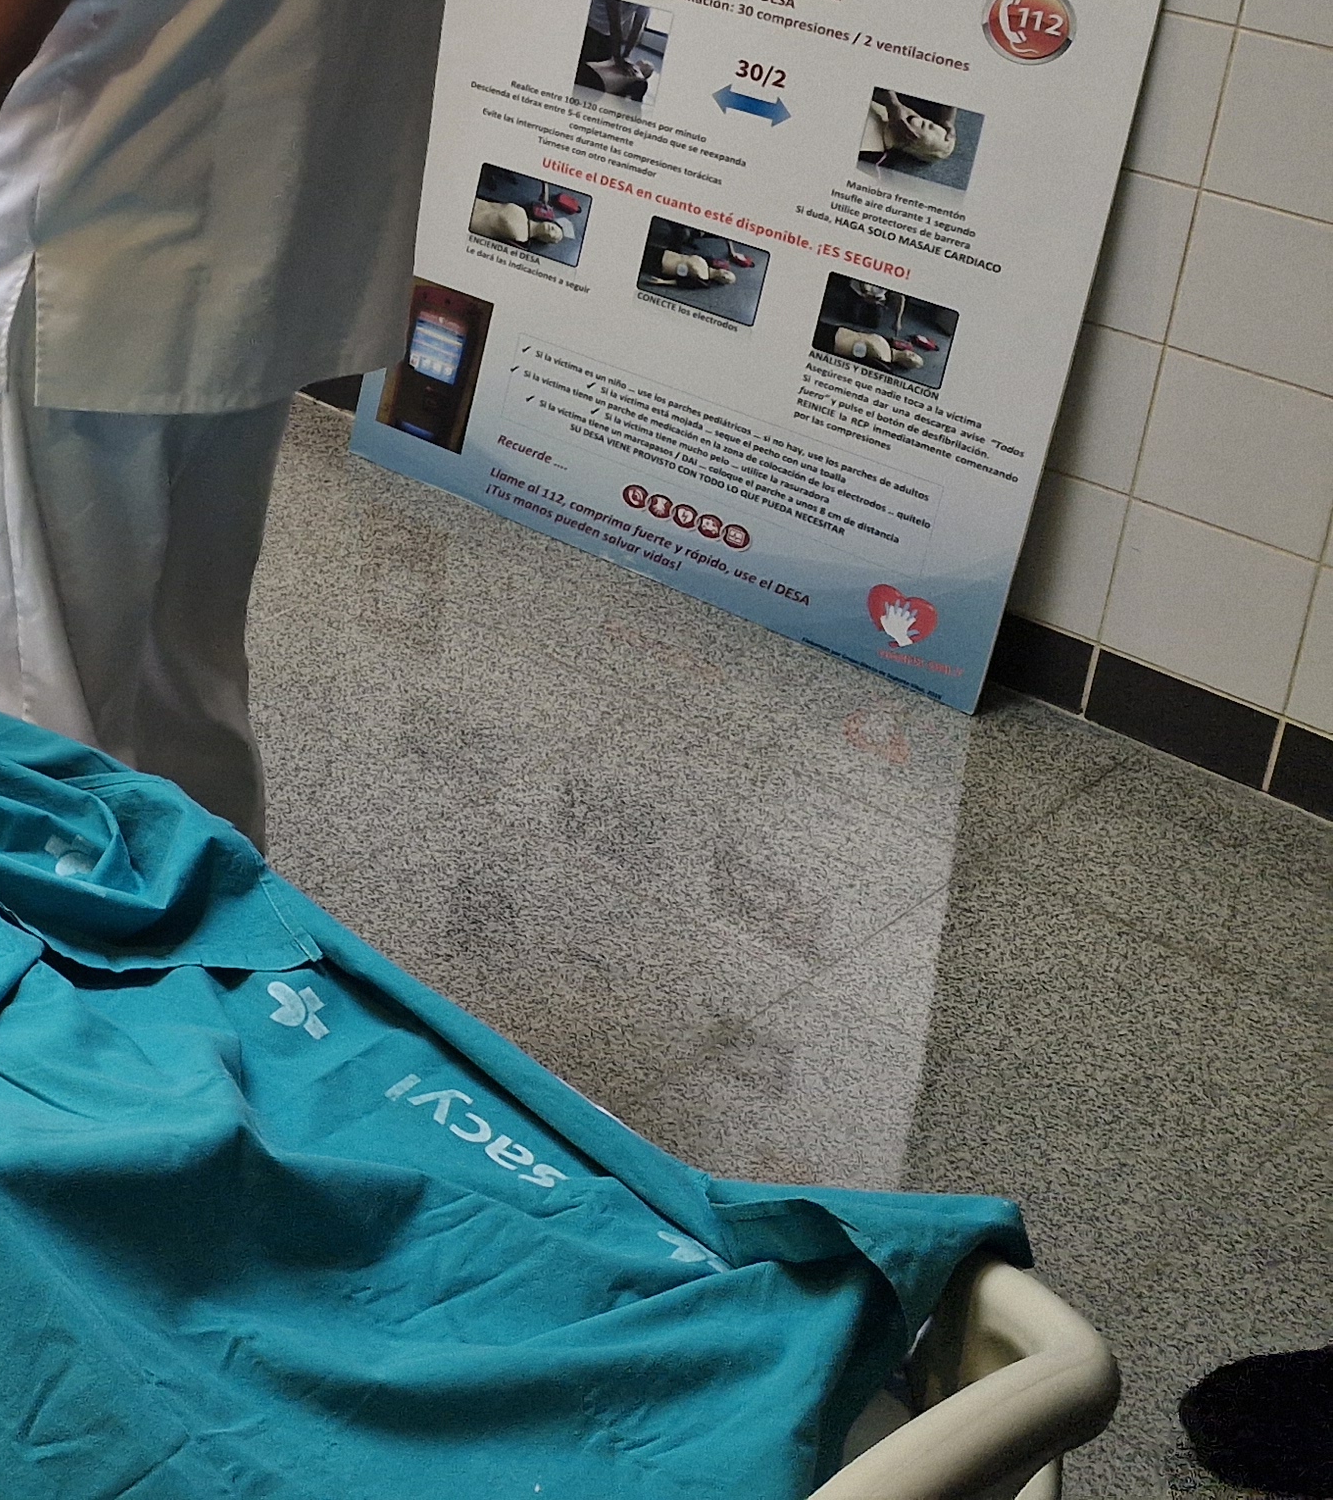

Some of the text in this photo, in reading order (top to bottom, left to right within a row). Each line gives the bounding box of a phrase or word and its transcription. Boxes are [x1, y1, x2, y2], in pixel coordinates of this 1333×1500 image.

[737, 3, 754, 17] 30
[755, 8, 850, 44] compresiones
[852, 32, 860, 46] /
[863, 35, 872, 47] 2
[875, 38, 971, 72] ventilaciones
[1014, 6, 1065, 38] 112
[733, 57, 788, 93] 30/2
[541, 156, 910, 281] Utilice el DESA en cuanto esté disponible. ¡ES SEGURO!
[795, 203, 1002, 274] Si duda, HAGA SOLO MASAJE CARDIACO
[498, 434, 552, 464] Recuerde
[485, 482, 680, 571] ¡Tus manos pueden salvar vidas!
[489, 466, 810, 607] Llame al 112, comprima fuerte y rápido, use el DESA
